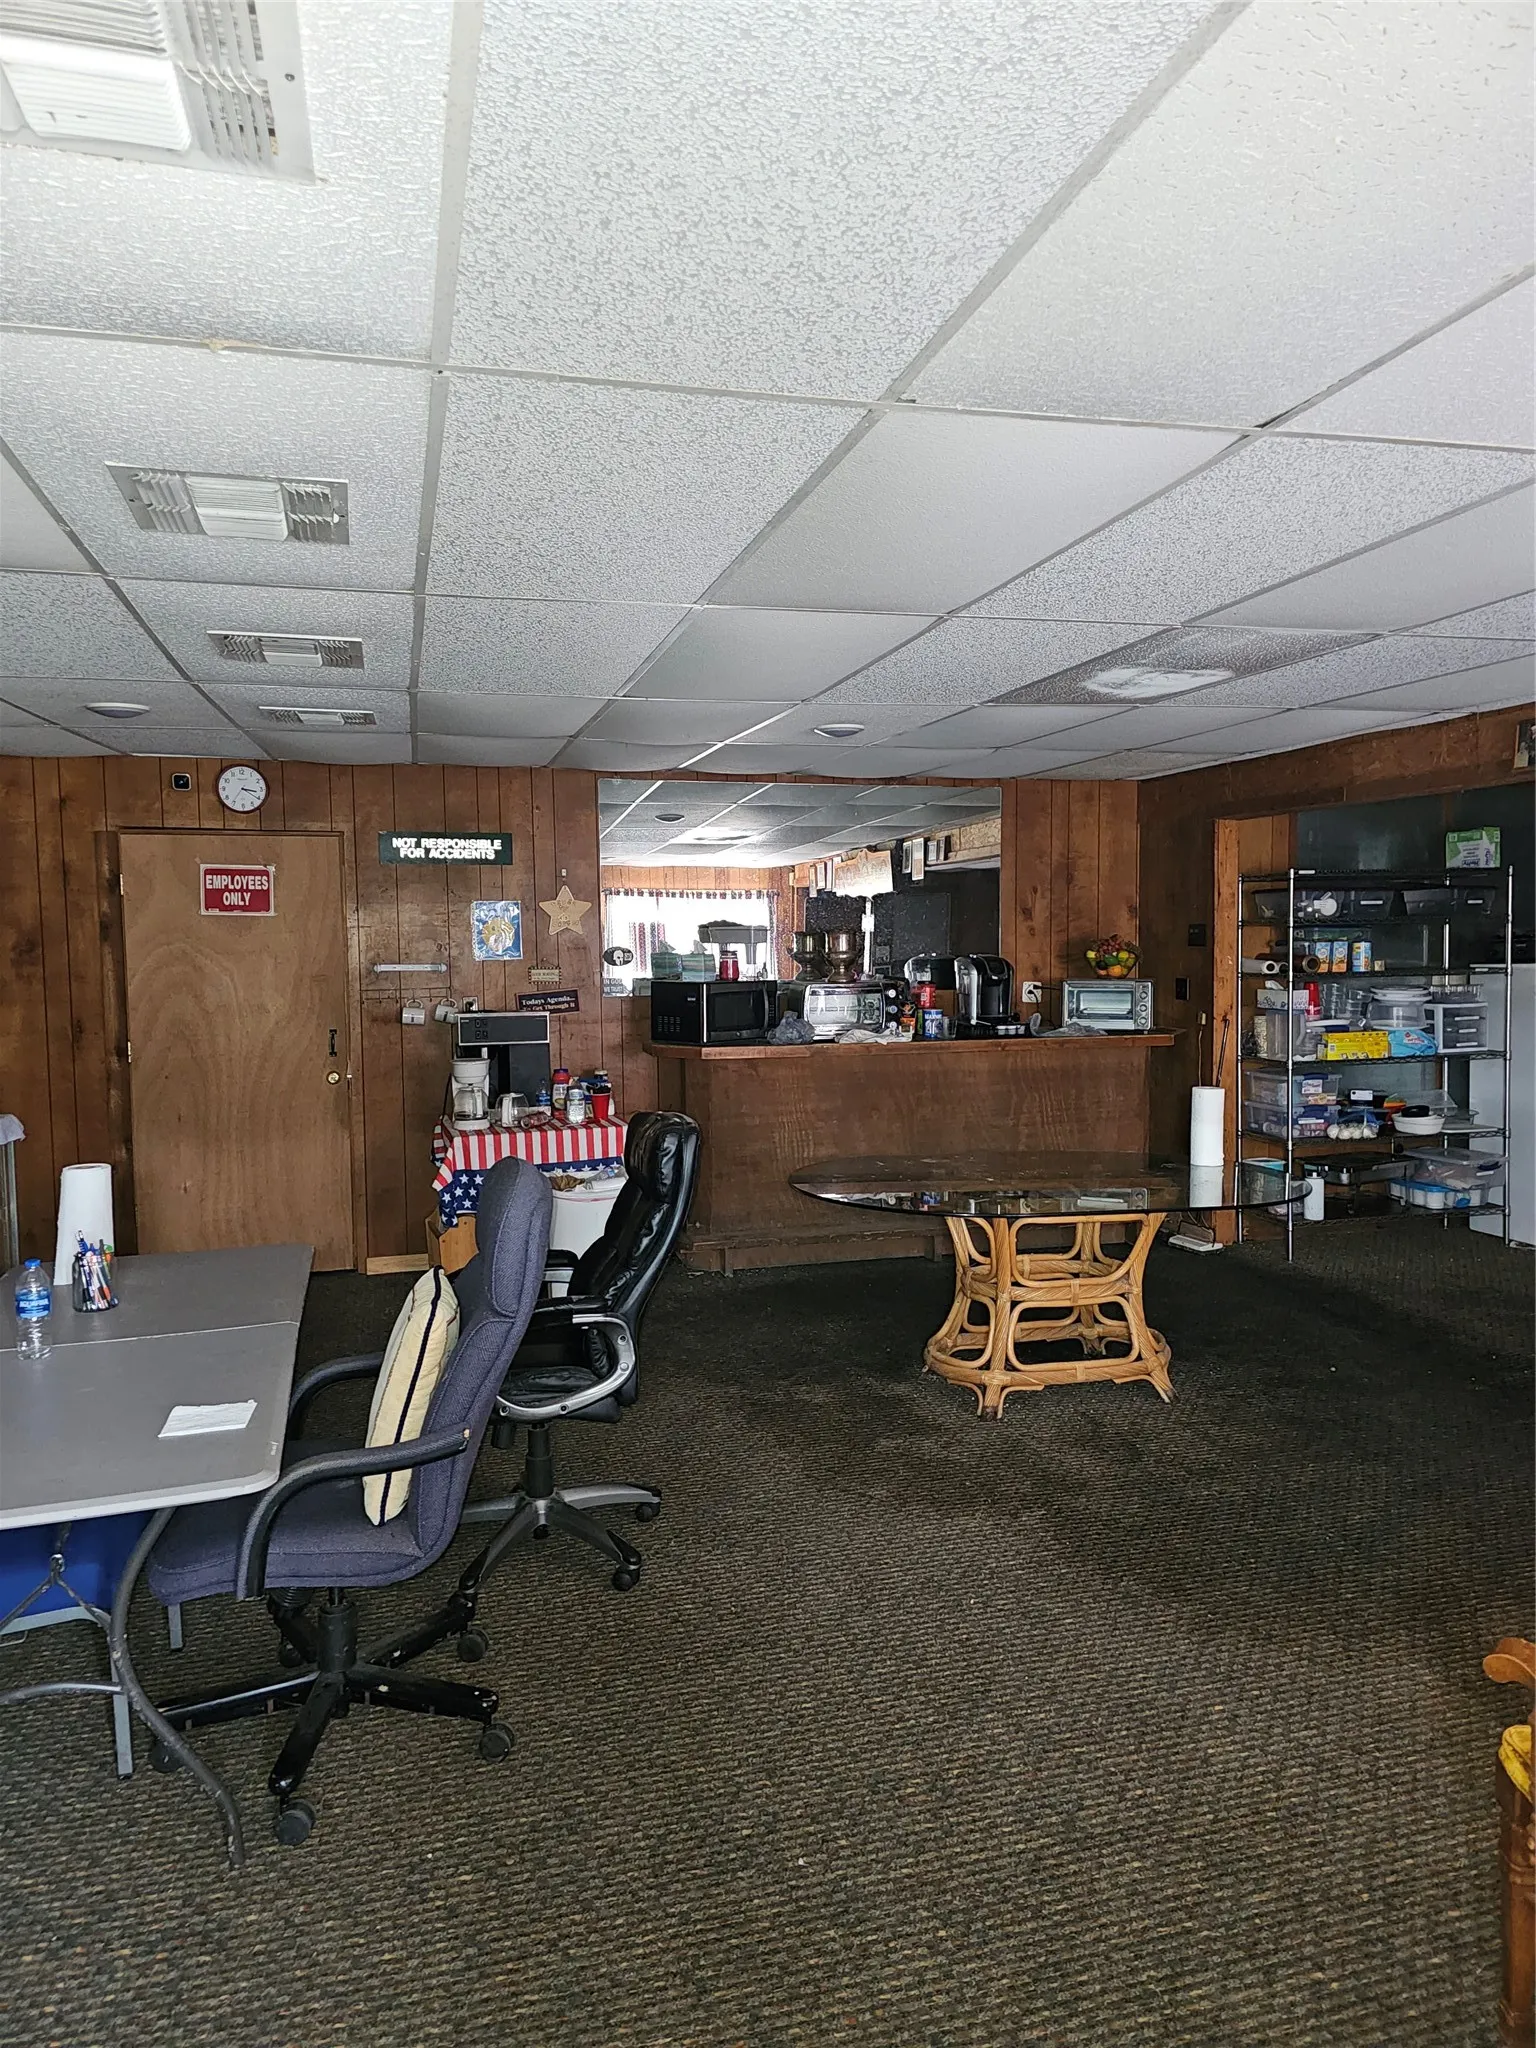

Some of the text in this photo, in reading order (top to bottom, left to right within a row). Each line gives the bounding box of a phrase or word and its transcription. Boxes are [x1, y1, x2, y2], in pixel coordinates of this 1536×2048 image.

[392, 837, 502, 850] NOT RESPONSIBLE
[400, 848, 495, 859] FOR ACCIDENTS
[205, 874, 269, 890] EMPLOYEES
[223, 891, 251, 906] ONLY
[522, 998, 545, 1006] Todays
[544, 1002, 569, 1010] Through
